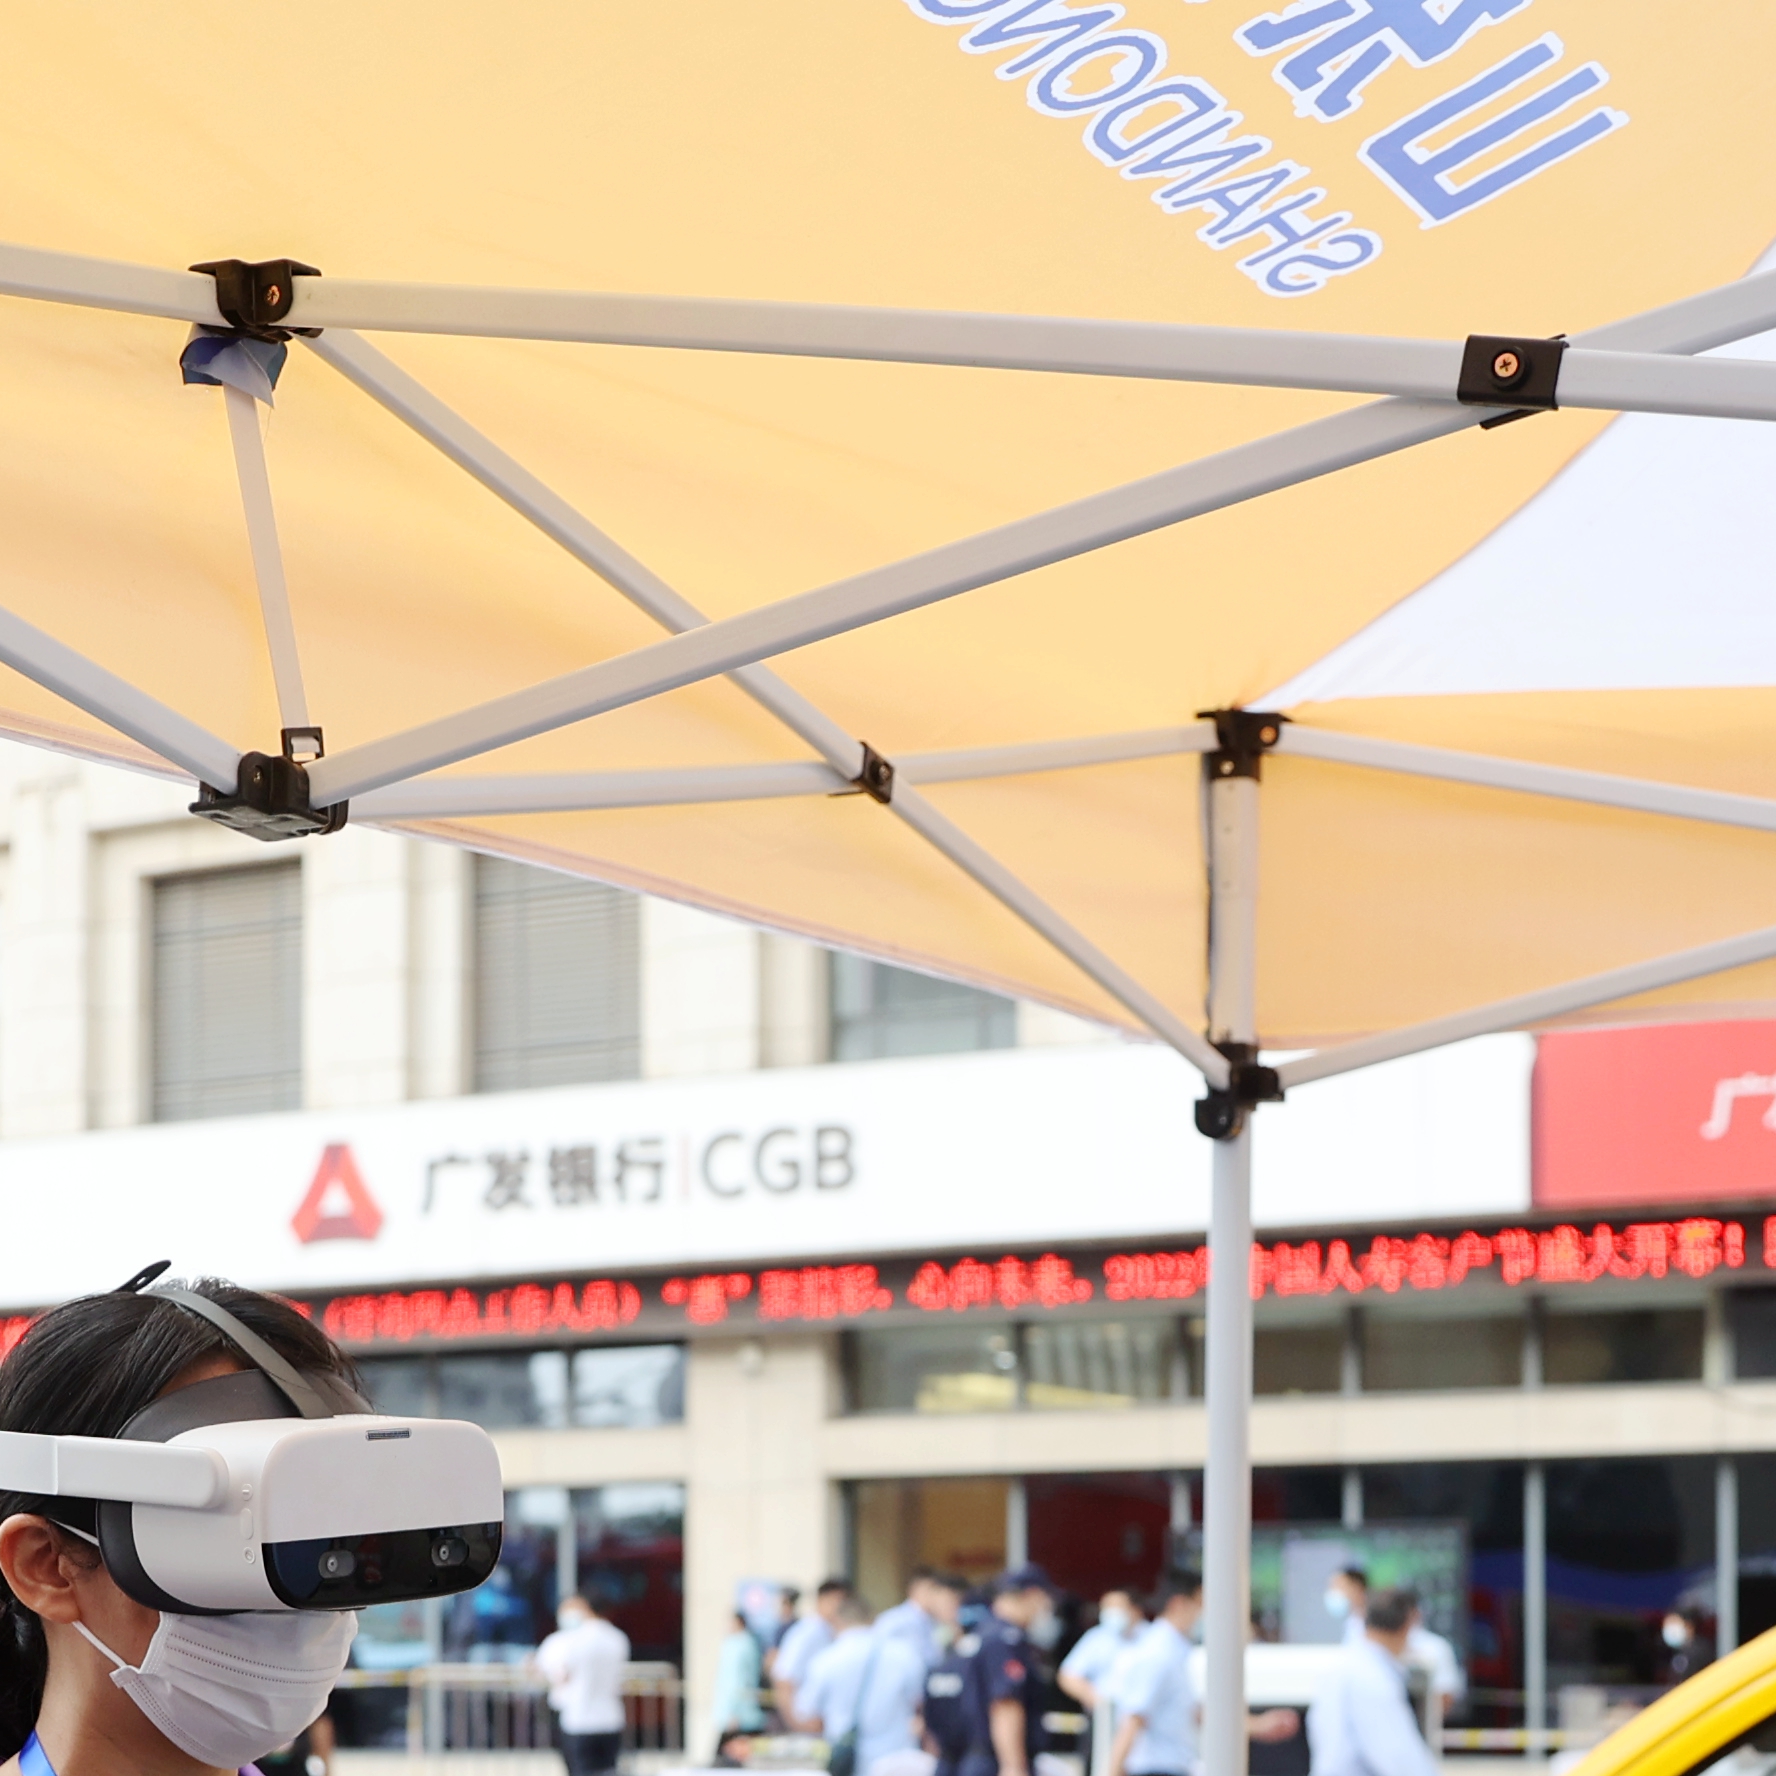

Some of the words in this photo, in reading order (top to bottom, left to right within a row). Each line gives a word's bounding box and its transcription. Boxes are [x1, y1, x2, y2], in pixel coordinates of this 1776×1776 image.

[423, 1135, 663, 1215] 广发银行
[699, 1124, 856, 1200] CGB
